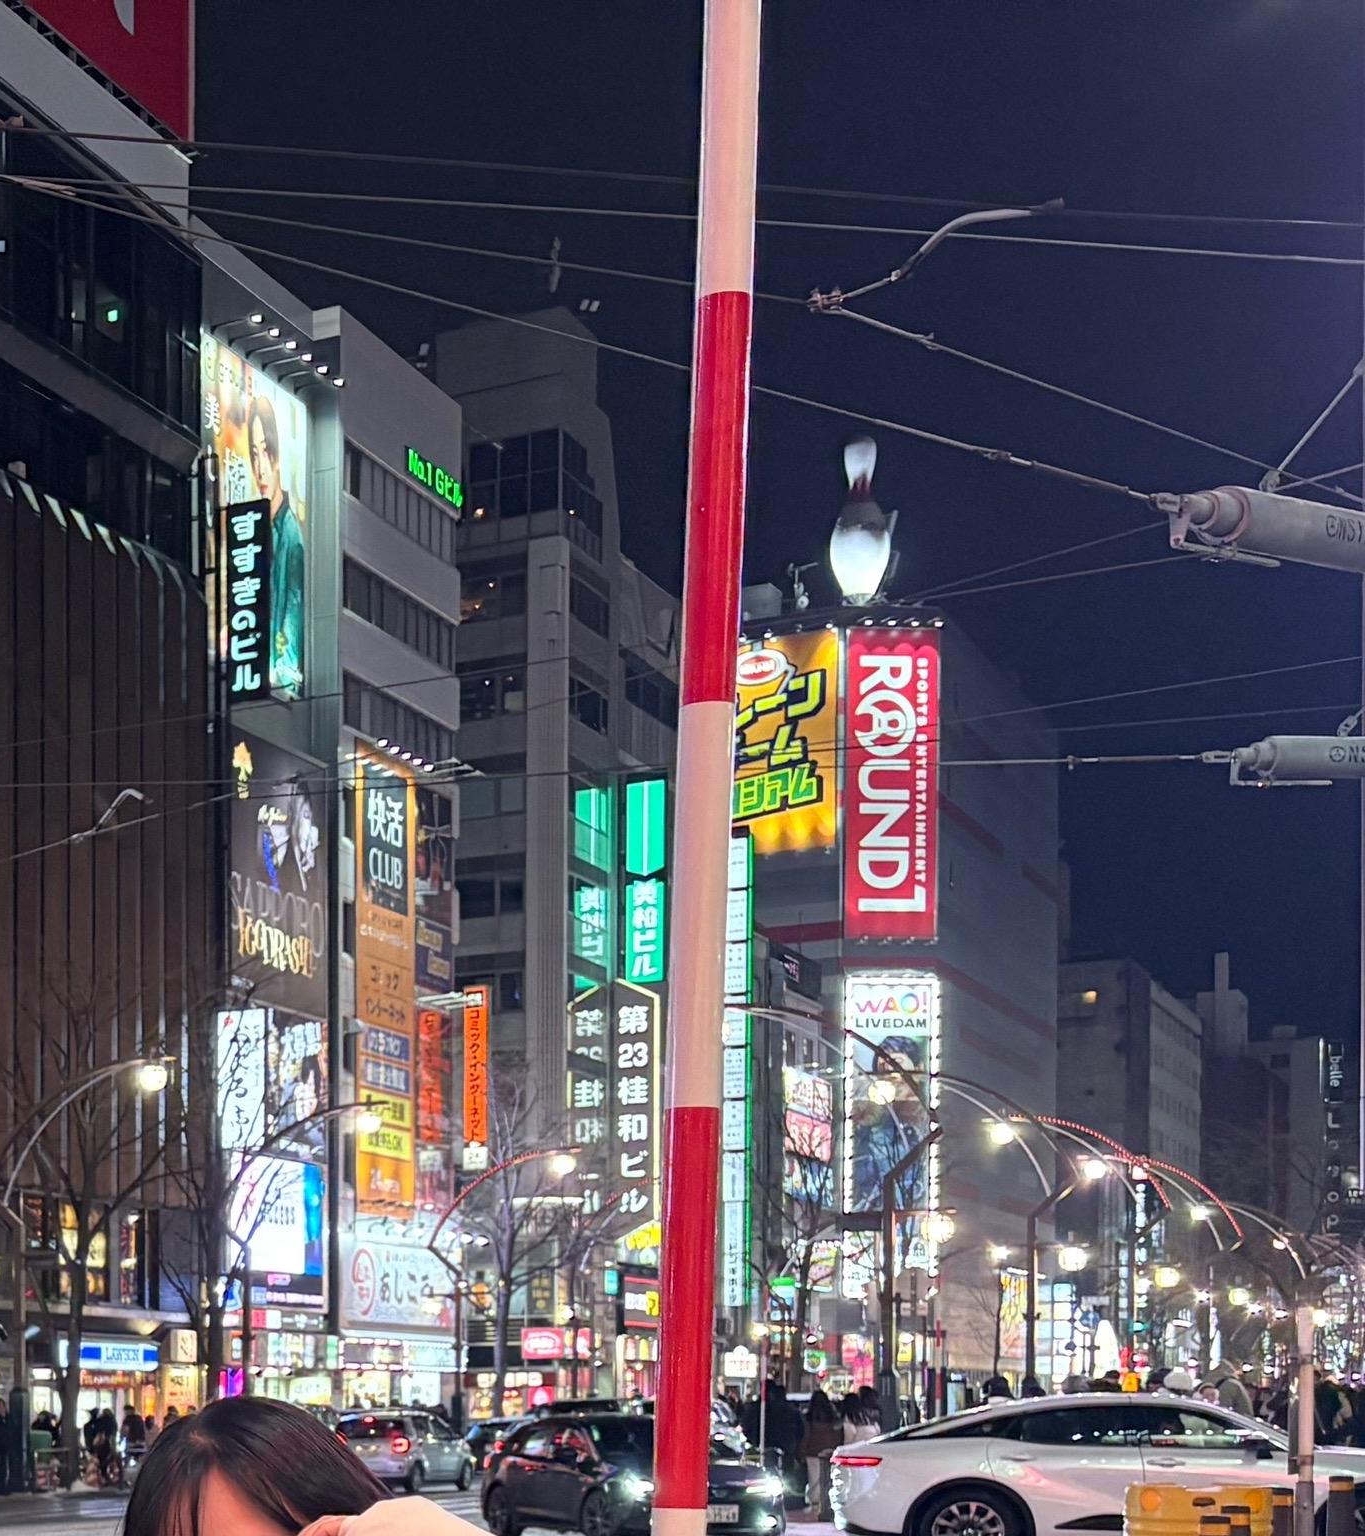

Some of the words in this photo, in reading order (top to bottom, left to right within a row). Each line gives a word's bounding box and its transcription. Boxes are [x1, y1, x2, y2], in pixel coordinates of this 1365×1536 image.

[915, 657, 929, 727] SPORTS
[367, 788, 404, 849] 快活
[915, 733, 928, 883] ENTERTAINMENT
[368, 847, 403, 891] CLUB
[855, 991, 929, 1015] WAO!
[855, 1017, 928, 1030] LIVEDAM
[616, 1004, 650, 1214] 第23桂和ビル
[105, 1345, 141, 1363] LAWSON
